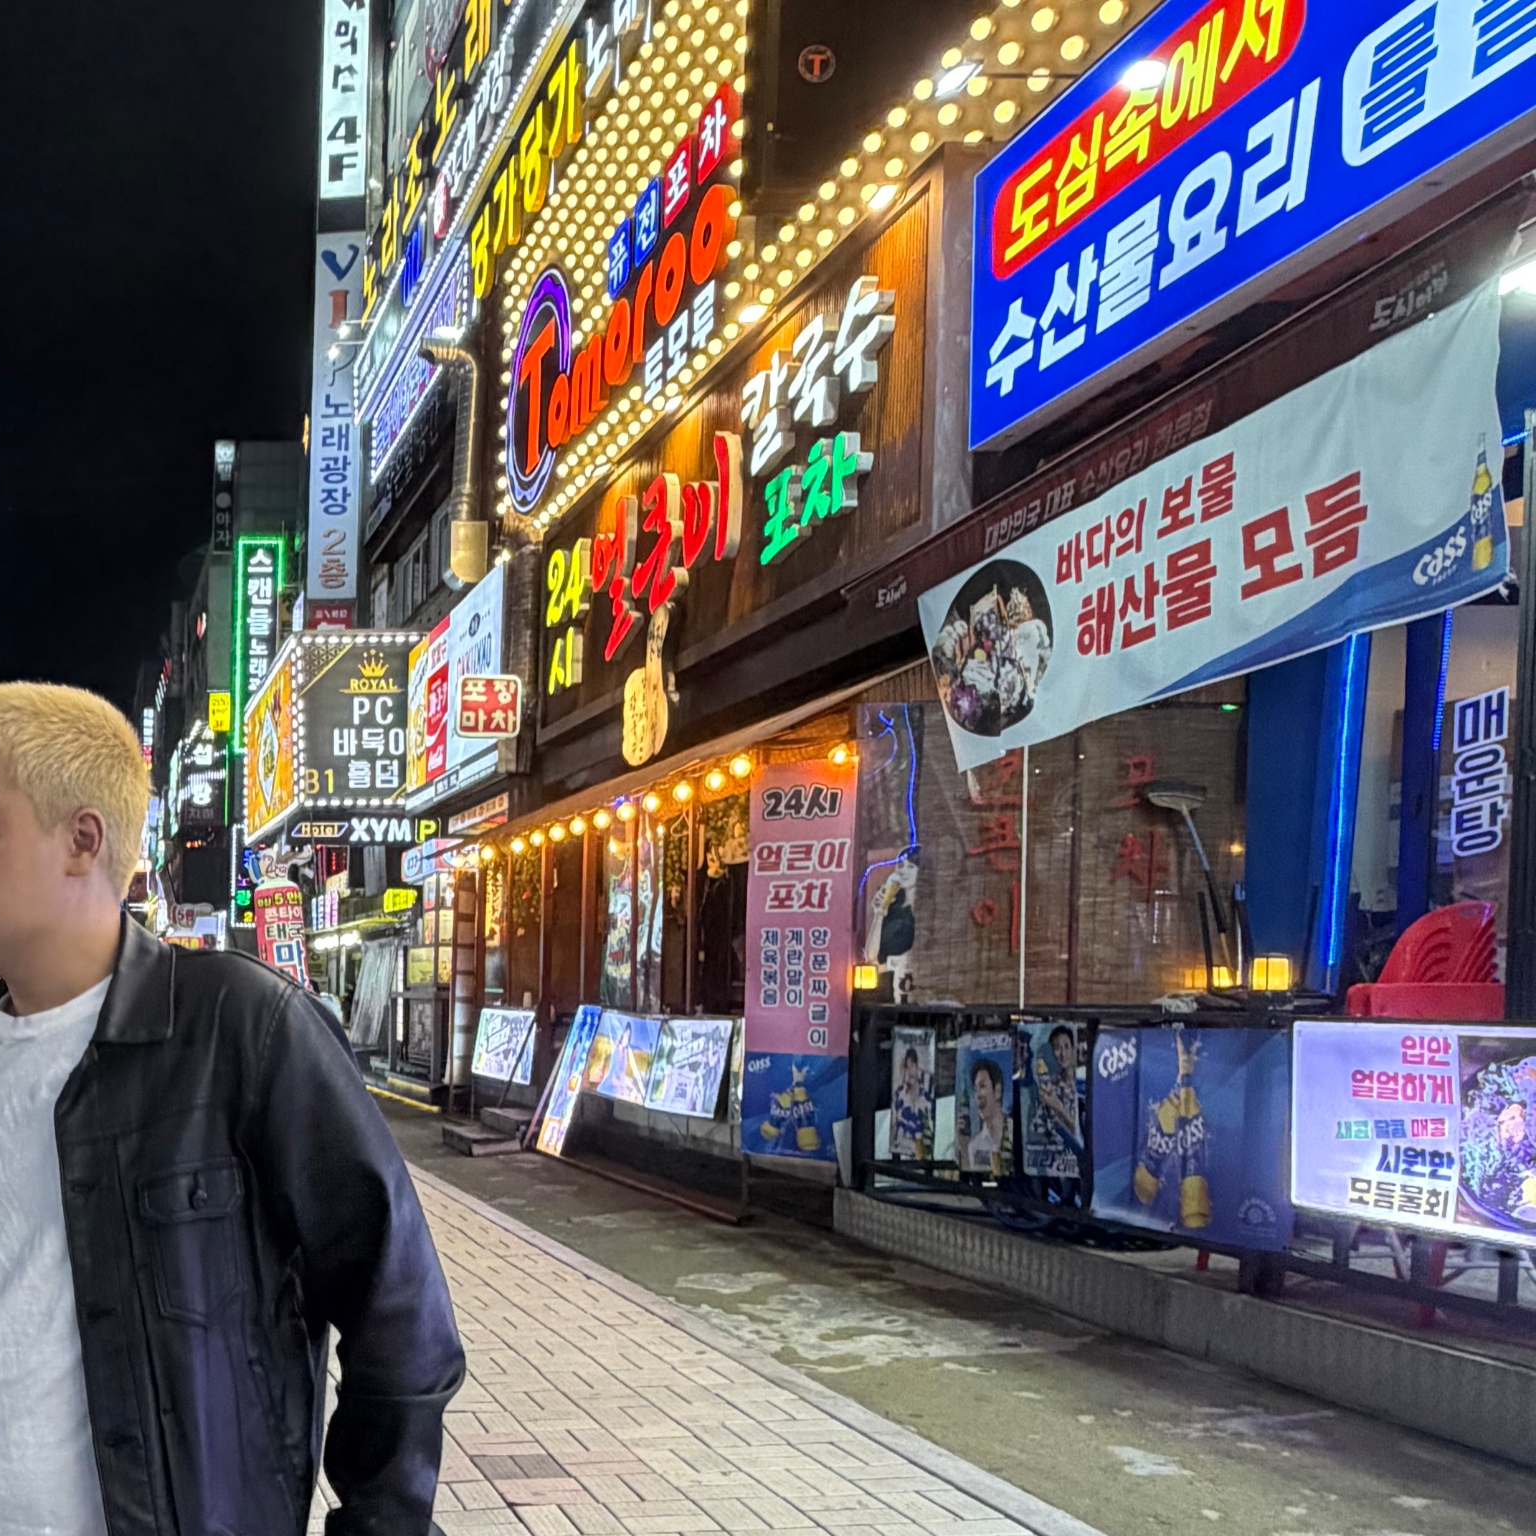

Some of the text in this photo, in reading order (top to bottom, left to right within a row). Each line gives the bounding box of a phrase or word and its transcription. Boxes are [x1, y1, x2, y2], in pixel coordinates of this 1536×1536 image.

[1004, 0, 1284, 262] 도심속에서
[985, 78, 1319, 397] 수산물요리
[519, 184, 736, 476] Tomoroo
[644, 281, 715, 404] 토모루
[741, 276, 895, 476] 칼국수
[319, 393, 352, 516] 노래광장
[761, 432, 872, 566] 포차
[1055, 452, 1237, 585] 바다의 보물
[318, 529, 348, 590] 2층
[1076, 471, 1368, 657] 해산물 모듬
[350, 677, 397, 691] ROYAL
[462, 679, 516, 705] 포장
[352, 695, 394, 726] PC
[462, 708, 516, 733] 마차
[305, 768, 334, 795] B1
[348, 759, 399, 789] 홀덤
[1452, 687, 1509, 856] 매운탕
[762, 783, 843, 821] 24시
[301, 817, 436, 842] Hotel XYM P
[754, 838, 851, 876] 얼큰이
[766, 879, 832, 913] 포차
[1400, 1035, 1452, 1067] 입안
[1351, 1069, 1454, 1104] 얼얼하게
[1335, 1119, 1371, 1140] 새콤
[1410, 1117, 1448, 1138] 매콤
[1375, 1143, 1455, 1182] 시원한
[1349, 1177, 1450, 1219] 모듬물회
